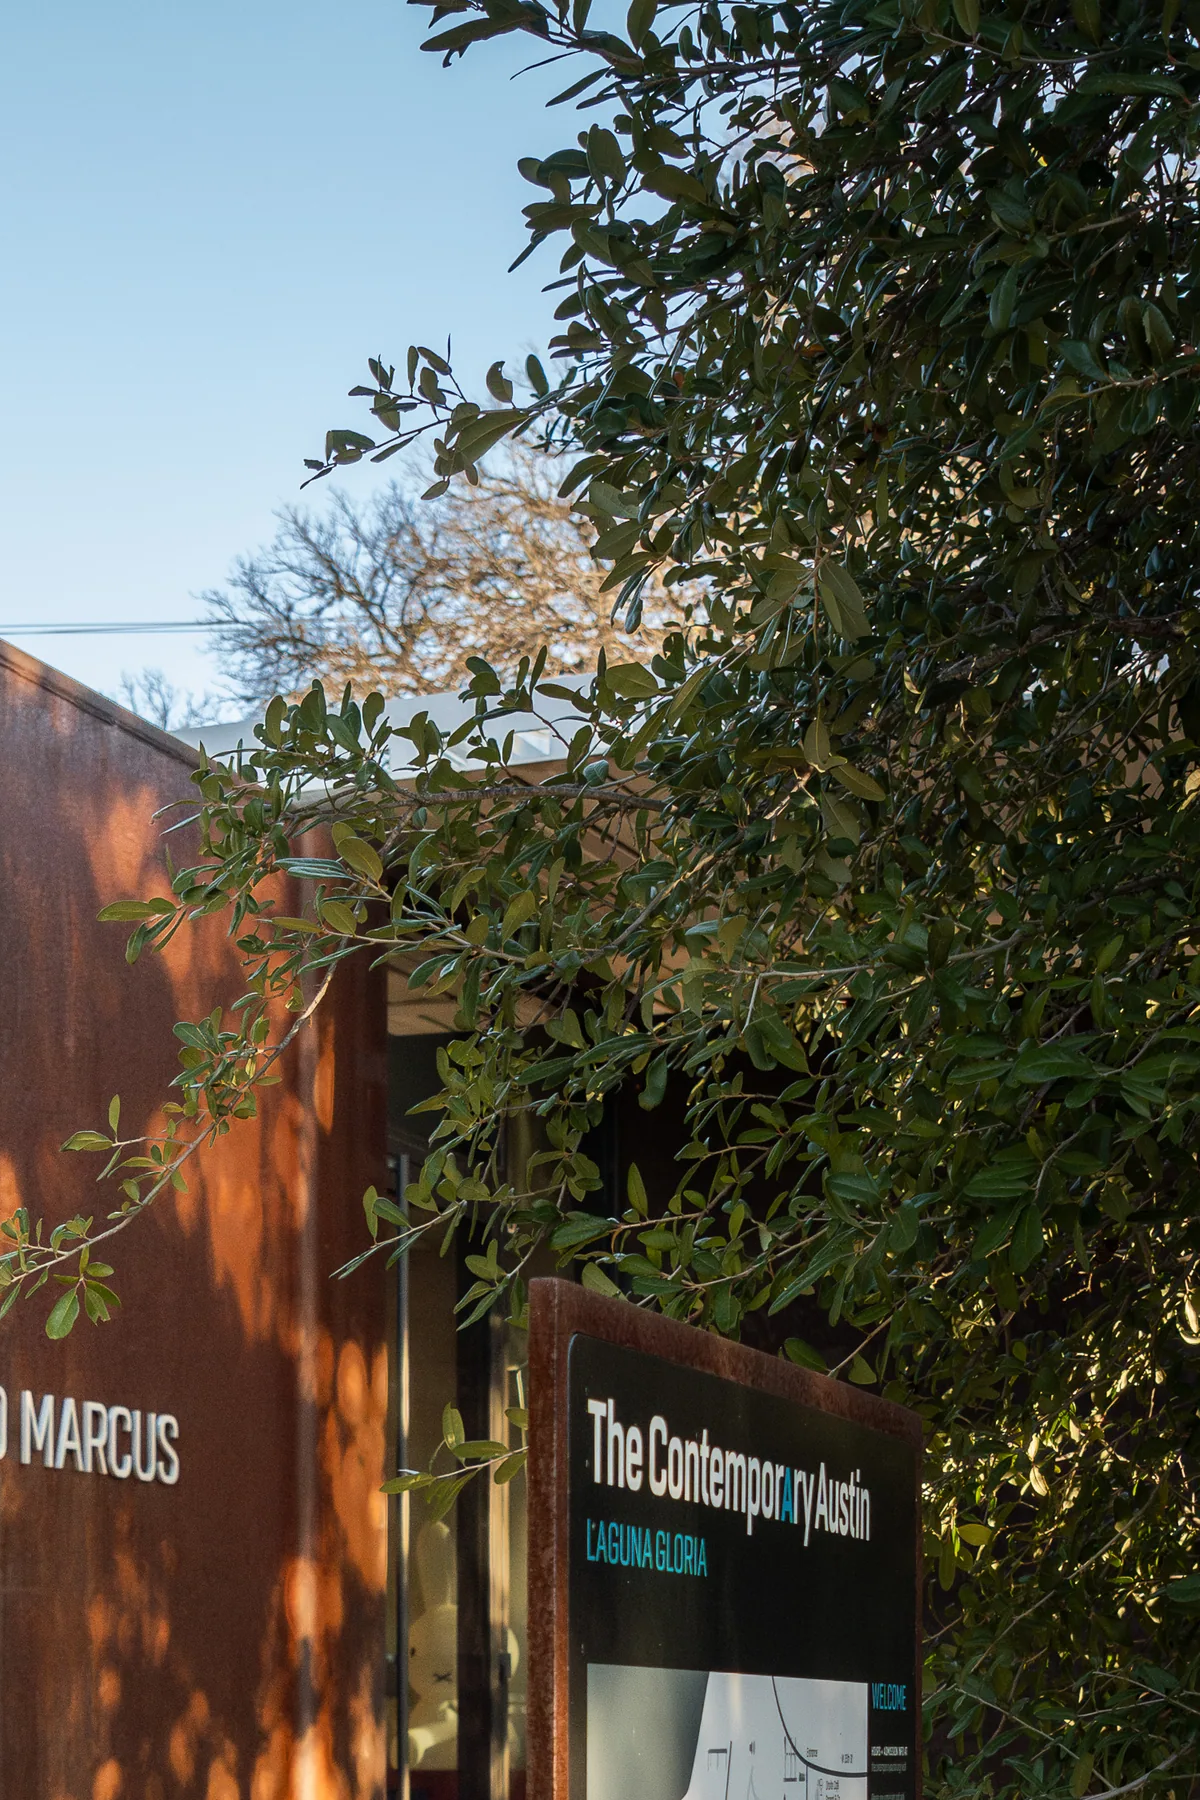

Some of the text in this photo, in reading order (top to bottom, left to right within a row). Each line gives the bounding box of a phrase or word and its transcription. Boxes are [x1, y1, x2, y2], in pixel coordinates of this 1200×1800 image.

[20, 1389, 180, 1486] MARCUS
[588, 1398, 643, 1491] The
[814, 1462, 871, 1541] Austin
[586, 1518, 708, 1577] LAGUNA GLORIA
[871, 1682, 907, 1711] WELCOME
